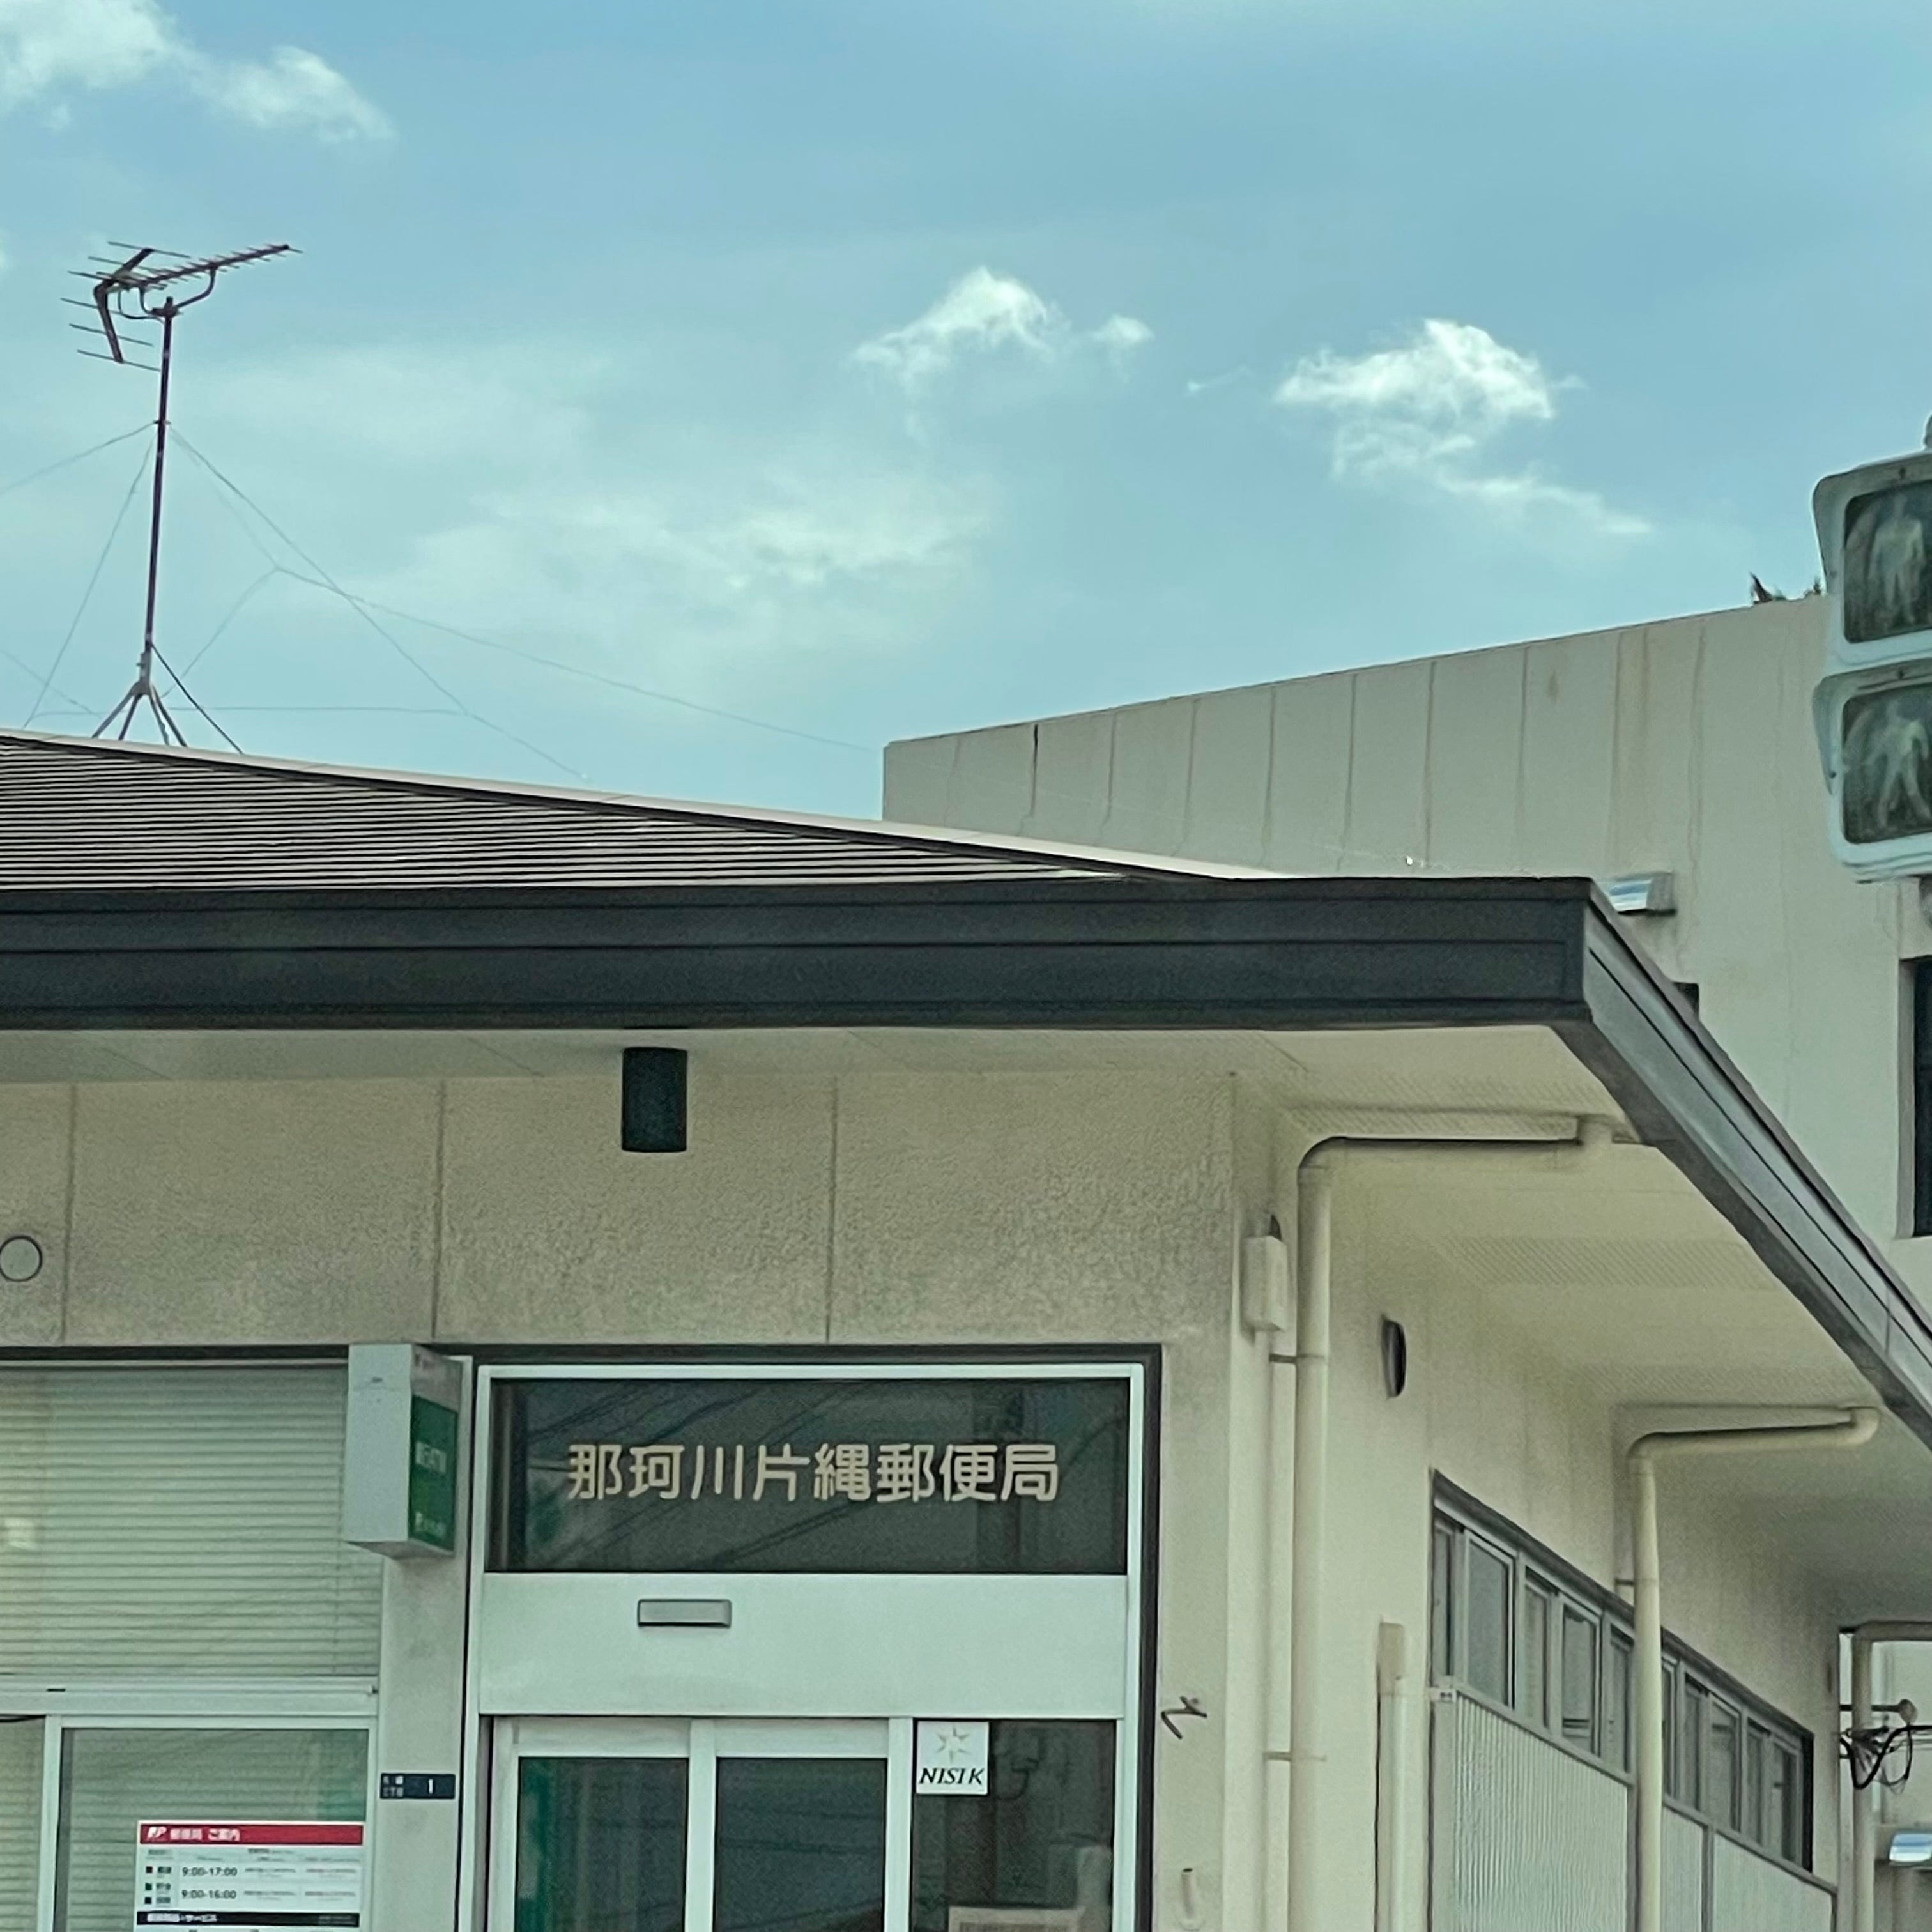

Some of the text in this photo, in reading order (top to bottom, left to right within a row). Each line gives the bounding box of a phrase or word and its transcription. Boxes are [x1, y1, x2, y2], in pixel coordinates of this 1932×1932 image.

[568, 1443, 1059, 1503] 那珂川片縄郵便局
[919, 1767, 985, 1785] NISIK
[181, 1866, 238, 1876] 9:00-17:00
[181, 1889, 237, 1899] 9:00-16:00
